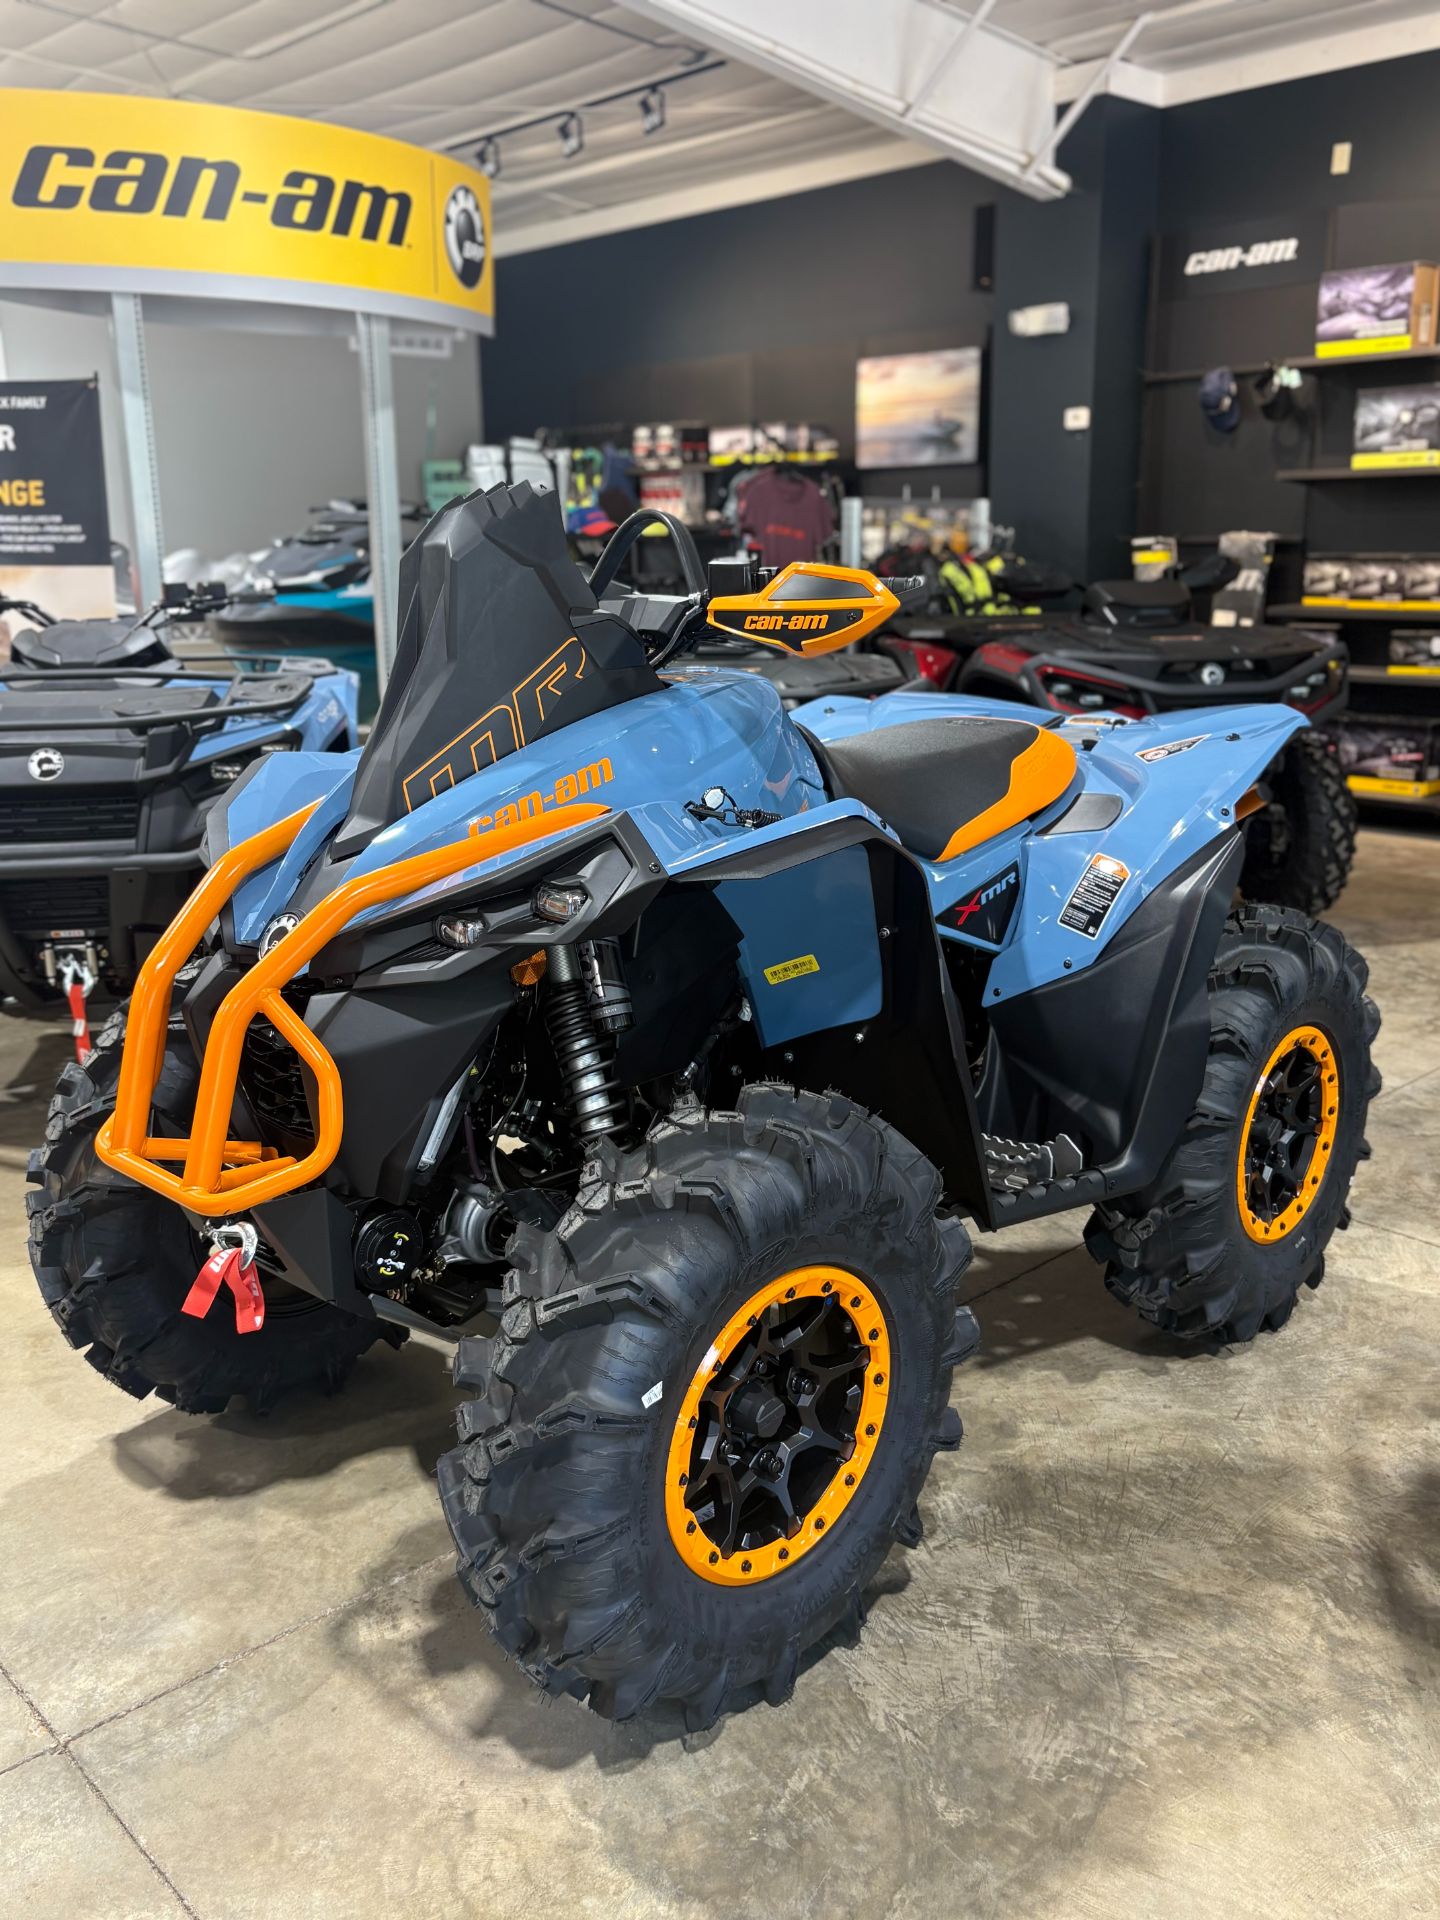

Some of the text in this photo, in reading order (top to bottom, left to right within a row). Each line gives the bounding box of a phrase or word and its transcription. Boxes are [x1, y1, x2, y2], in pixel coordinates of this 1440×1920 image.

[12, 145, 410, 247] can-am
[1184, 237, 1299, 276] can-am
[744, 613, 829, 631] can-am
[468, 756, 615, 839] can-am
